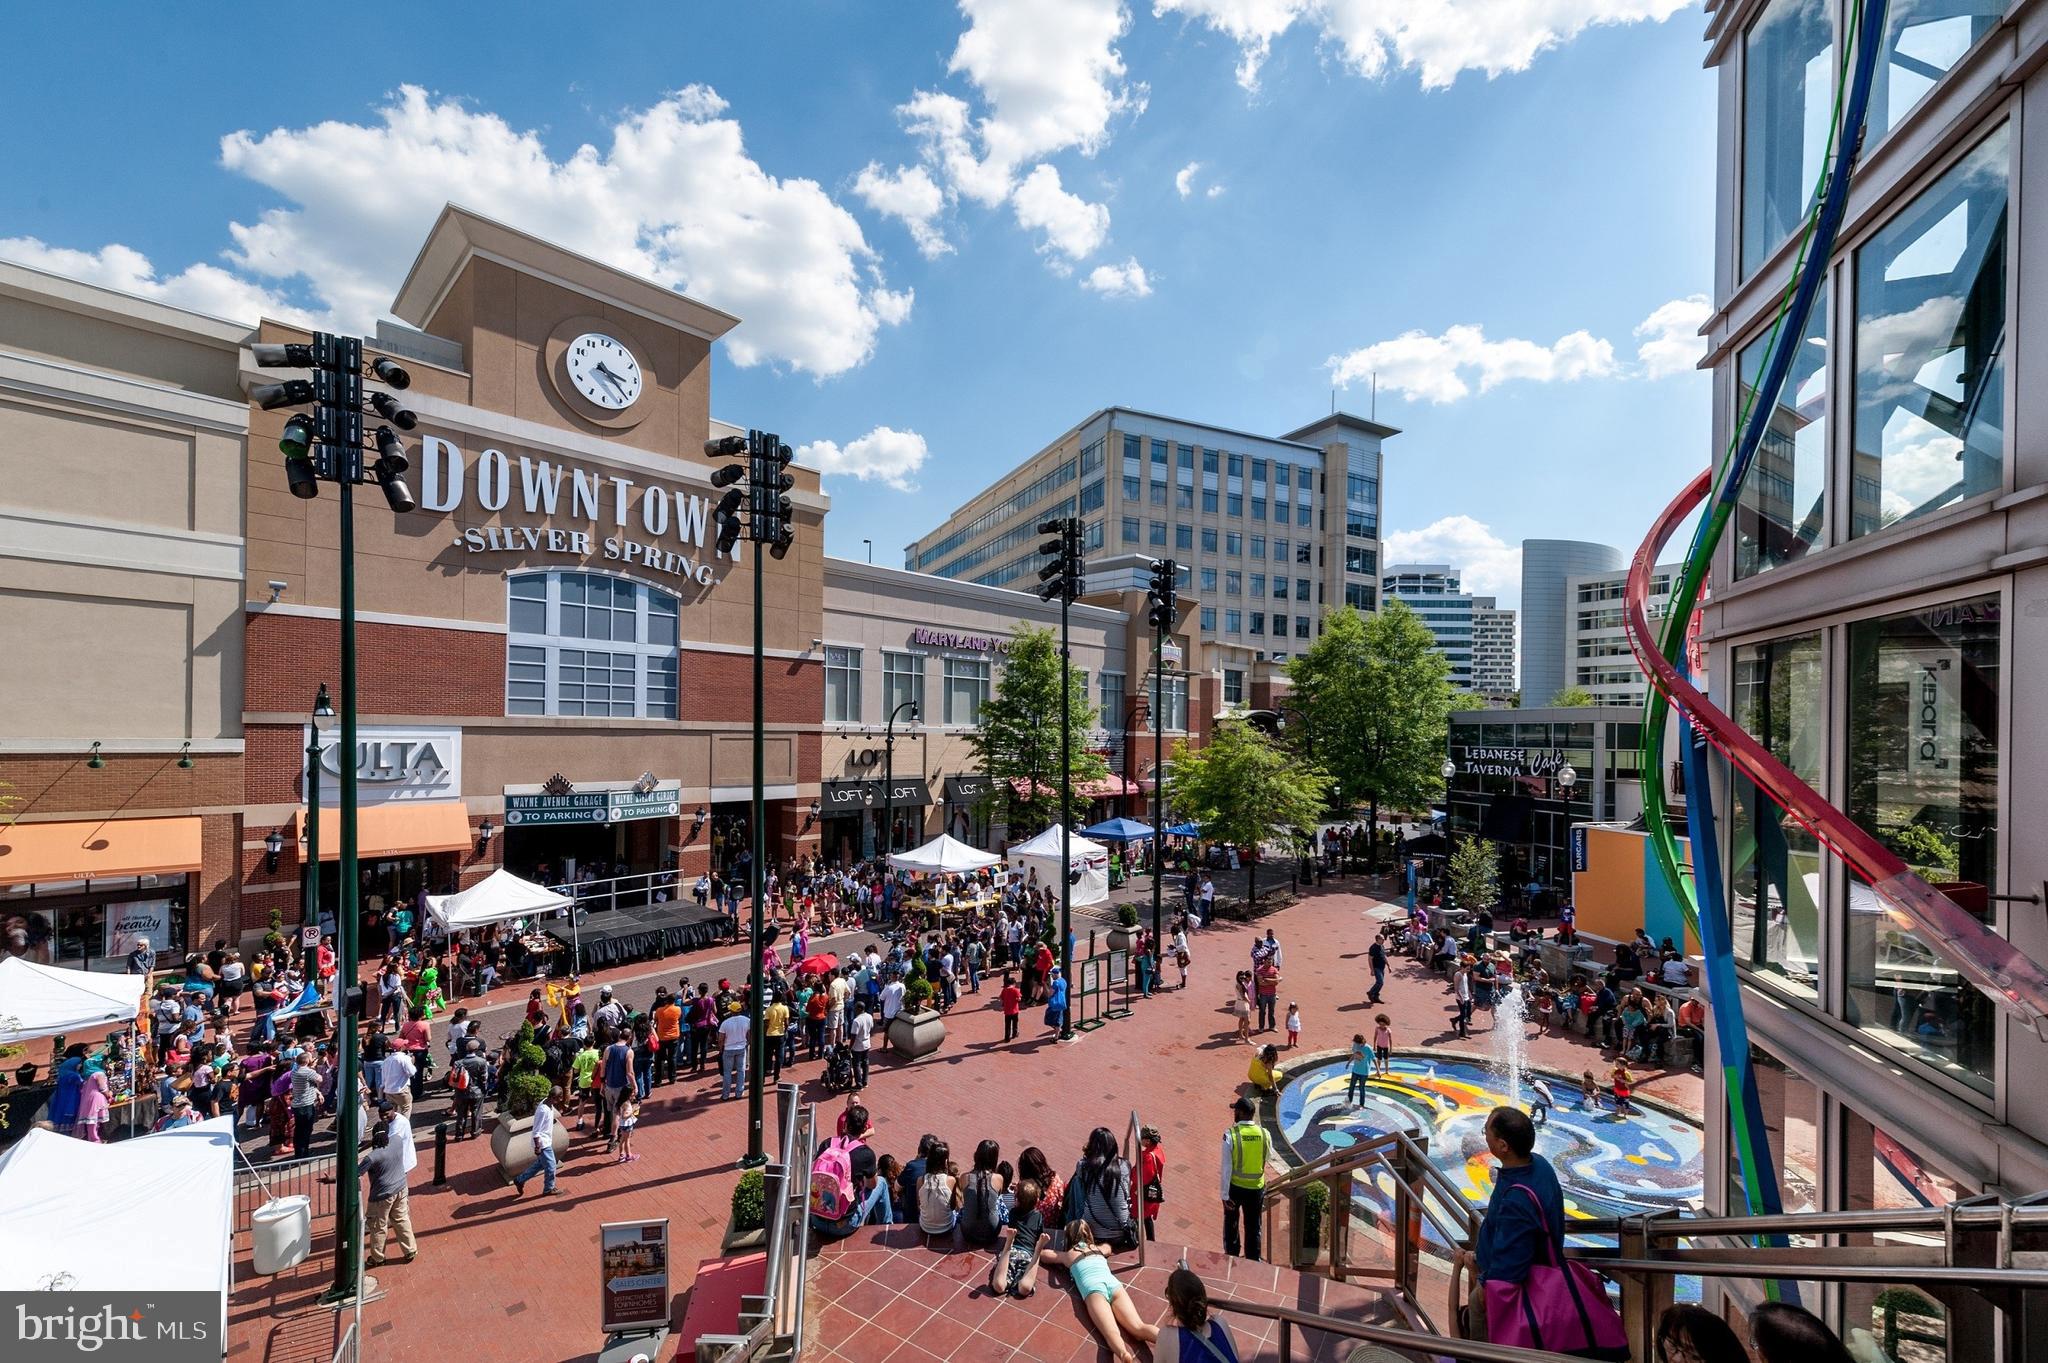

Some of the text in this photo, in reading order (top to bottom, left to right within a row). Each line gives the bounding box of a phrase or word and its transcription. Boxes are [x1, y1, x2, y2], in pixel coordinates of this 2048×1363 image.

[464, 527, 715, 587] SILVER SPRING
[914, 628, 989, 651] MARYLAND
[851, 749, 894, 766] LOF
[1465, 746, 1525, 761] LEBANESE
[1465, 761, 1521, 776] TAVERNA
[512, 795, 603, 808] WAYNE AVENUE GARAGE
[830, 789, 863, 802] LOFT
[524, 811, 591, 821] TO PARKING
[636, 806, 668, 815] PARKING
[114, 917, 162, 932] beauty
